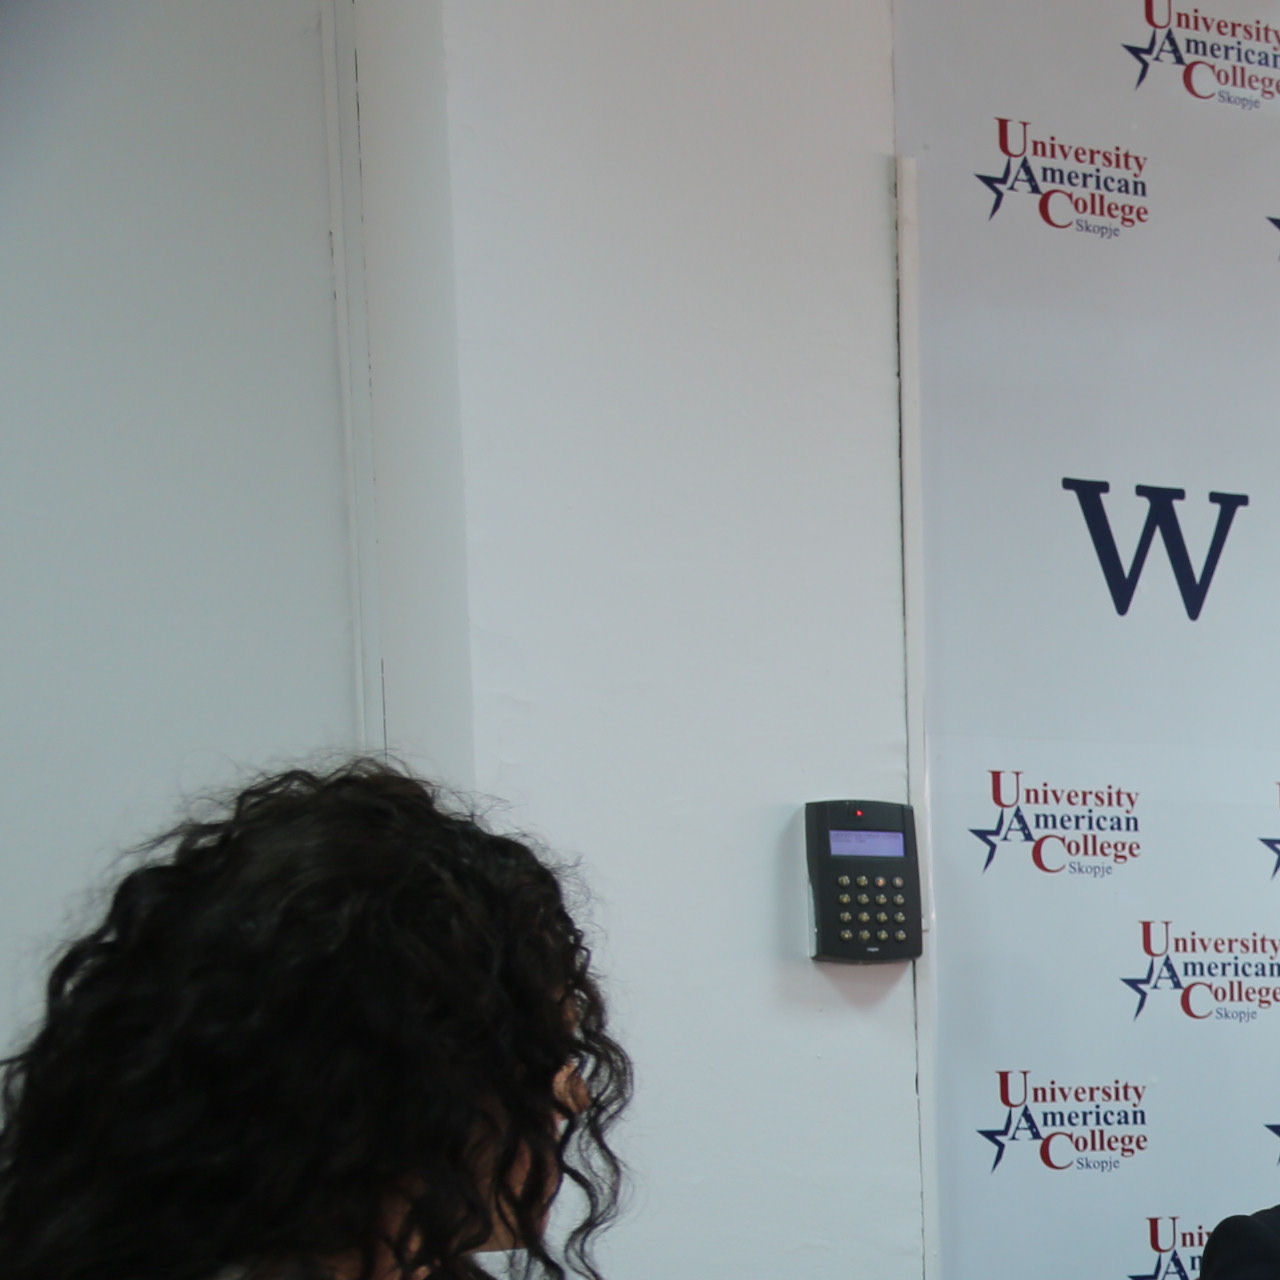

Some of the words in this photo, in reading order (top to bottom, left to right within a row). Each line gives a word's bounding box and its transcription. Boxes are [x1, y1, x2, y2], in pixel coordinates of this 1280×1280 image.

[1218, 91, 1260, 111] Skopje
[994, 117, 1147, 178] University
[1007, 156, 1148, 198] American
[1039, 190, 1148, 229] College
[1076, 220, 1120, 239] Skopje
[987, 770, 1139, 814] University
[1000, 806, 1140, 842] American
[1032, 834, 1140, 873] College
[1069, 862, 1112, 878] Skopje
[1216, 1007, 1257, 1023] Skopje
[995, 1071, 1146, 1107] University
[1009, 1105, 1147, 1140] American
[1040, 1130, 1147, 1170] College
[1077, 1157, 1119, 1172] Skopje
